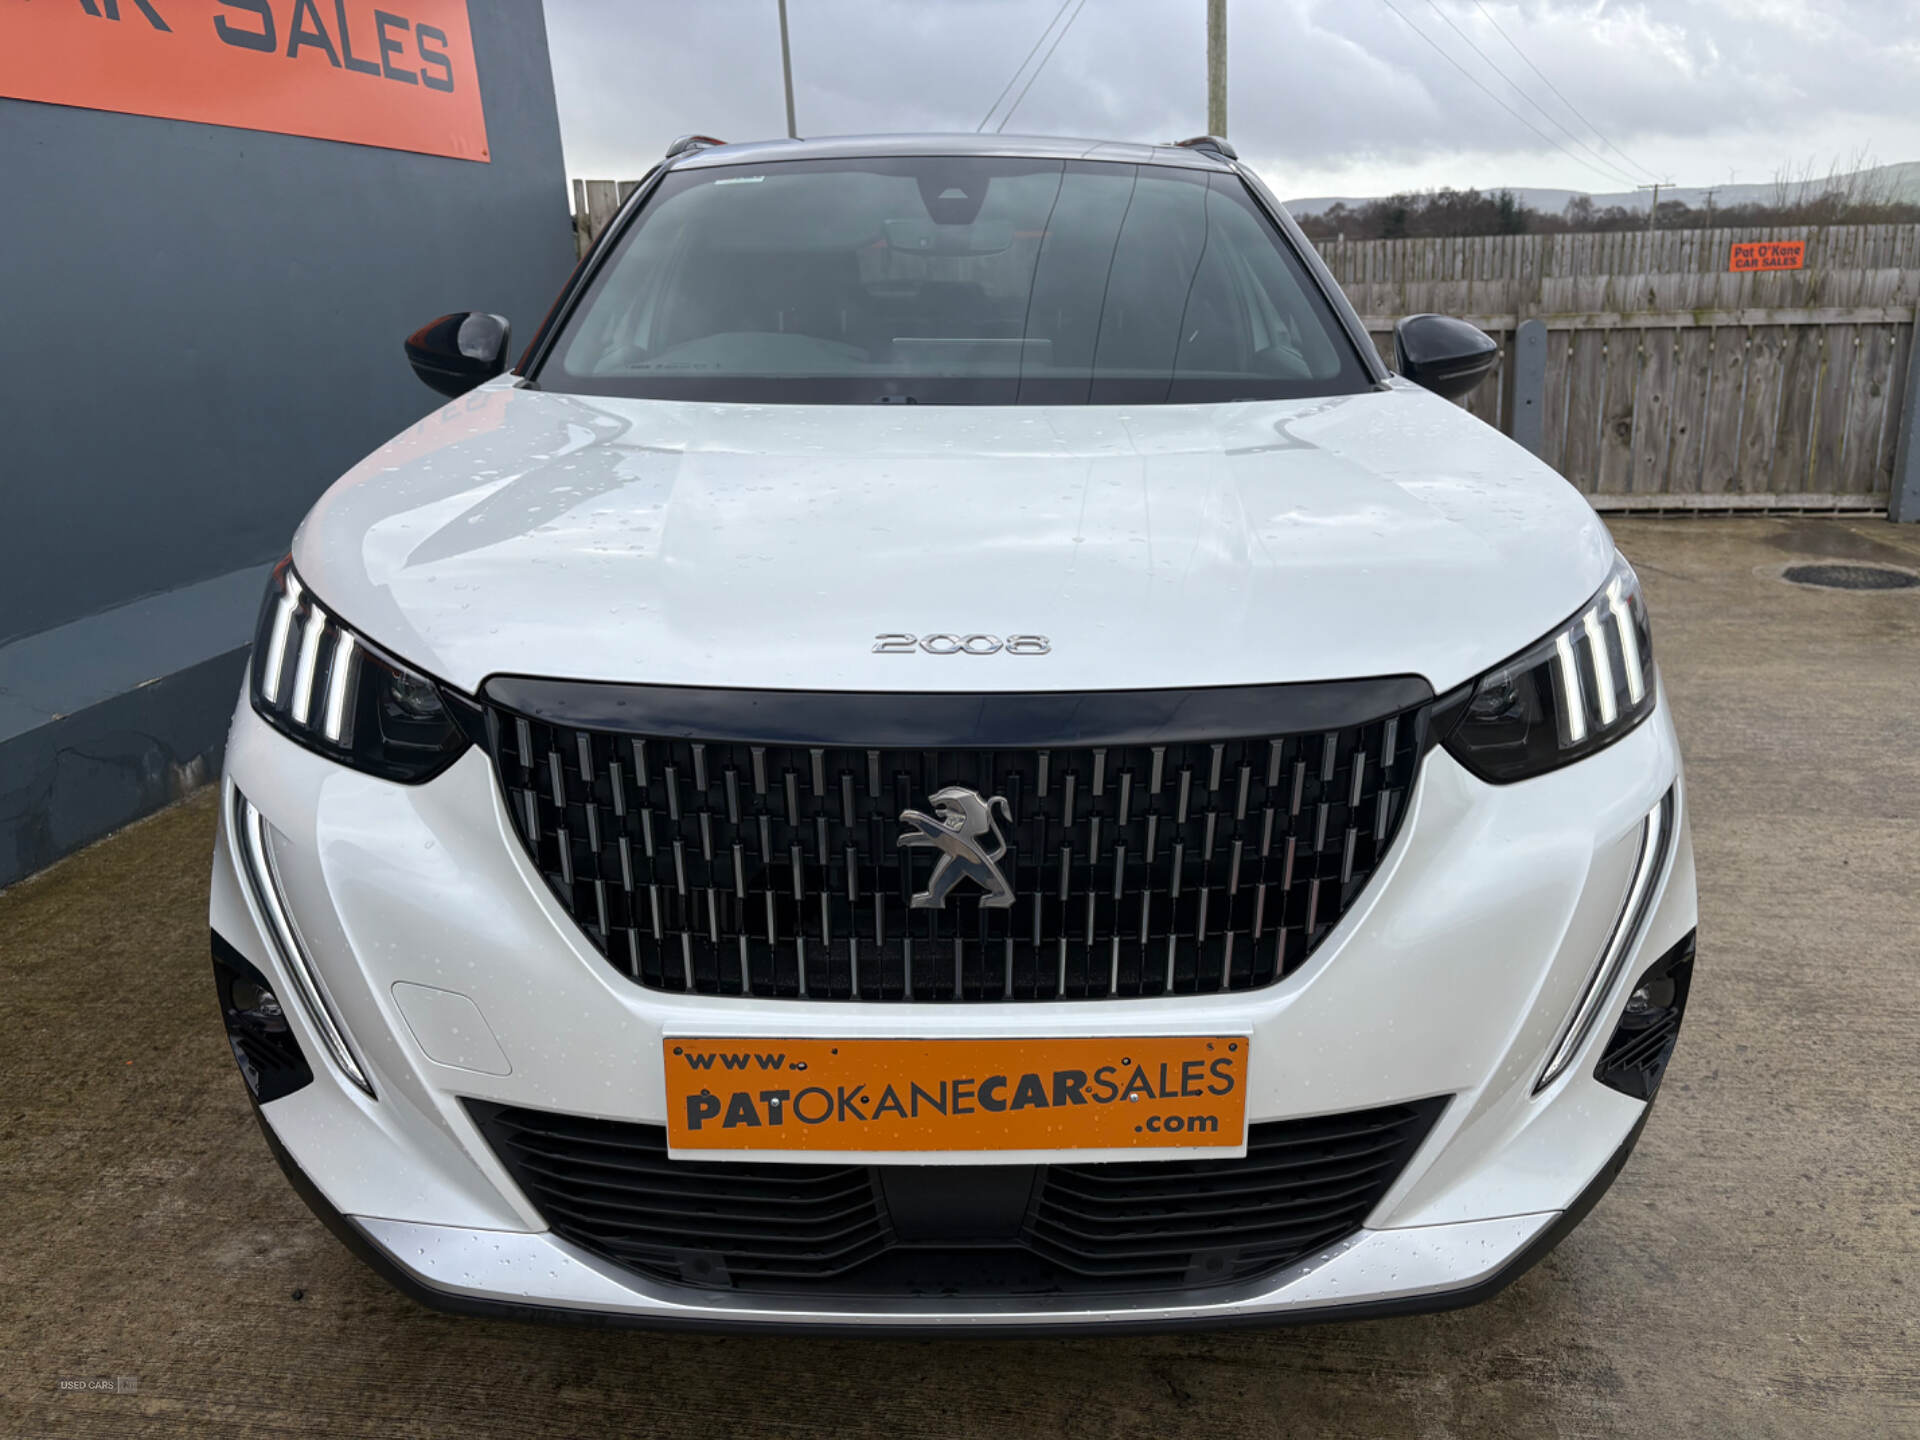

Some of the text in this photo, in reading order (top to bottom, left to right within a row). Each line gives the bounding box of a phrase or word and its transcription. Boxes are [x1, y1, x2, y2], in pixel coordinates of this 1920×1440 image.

[1735, 245, 1801, 258] Pat O'Kane
[1735, 257, 1797, 268] CAR SALES
[871, 633, 1052, 655] 2008
[684, 1053, 797, 1070] www.
[686, 1058, 1235, 1130] PATOKANECARSALES
[1134, 1115, 1219, 1133] .com
